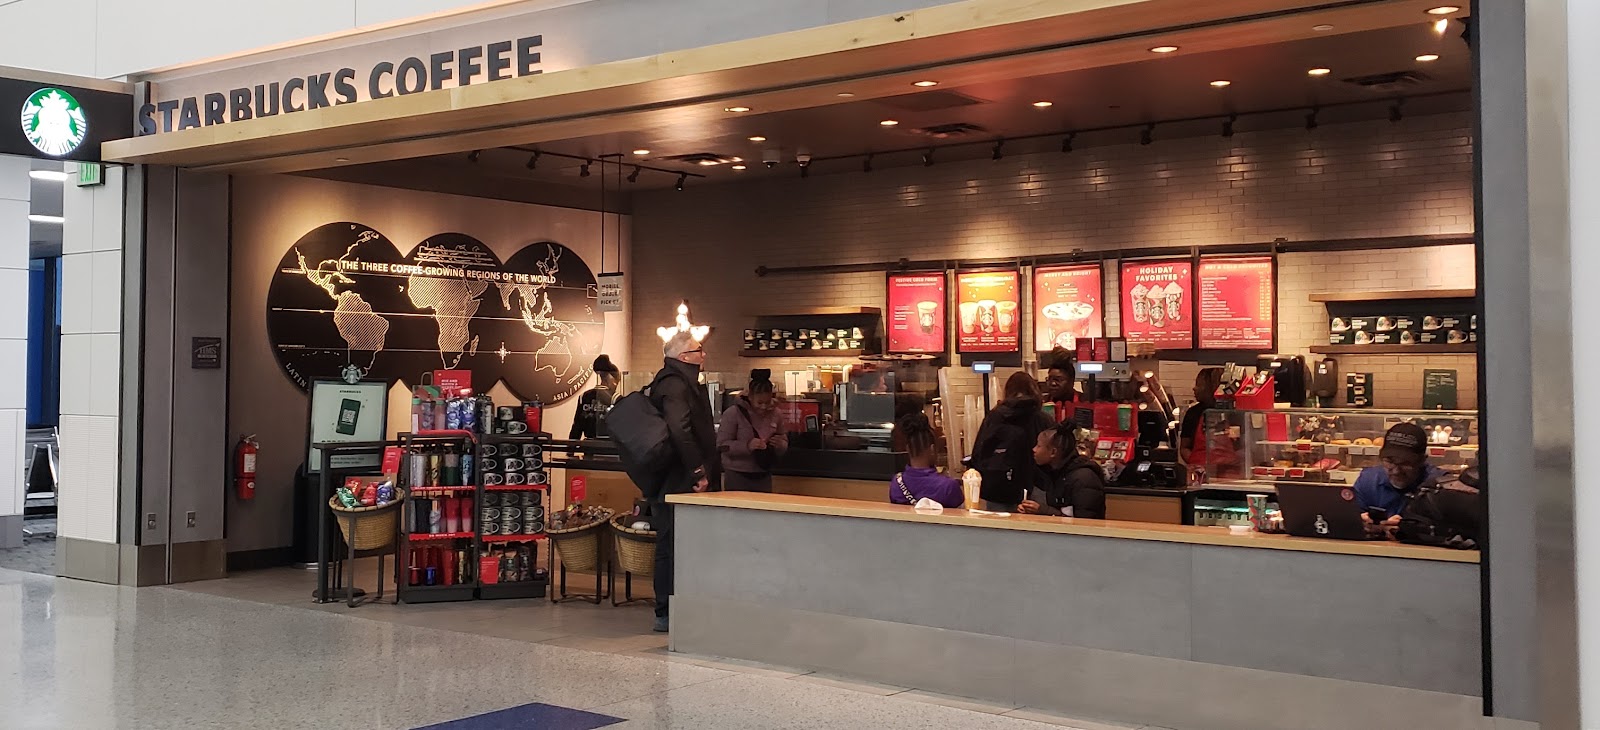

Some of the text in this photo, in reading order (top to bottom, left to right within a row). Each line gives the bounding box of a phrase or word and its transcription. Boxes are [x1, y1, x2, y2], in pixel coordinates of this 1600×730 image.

[138, 35, 543, 136] STARBUCKS COFFEE
[341, 260, 556, 284] THE THREE COFFEE-GROWING REGIONS OF THE WORLD
[1135, 274, 1178, 282] FAVORITES
[1140, 266, 1174, 275] HOLIDAY
[285, 362, 307, 388] LATIN
[552, 391, 569, 401] ASIA
